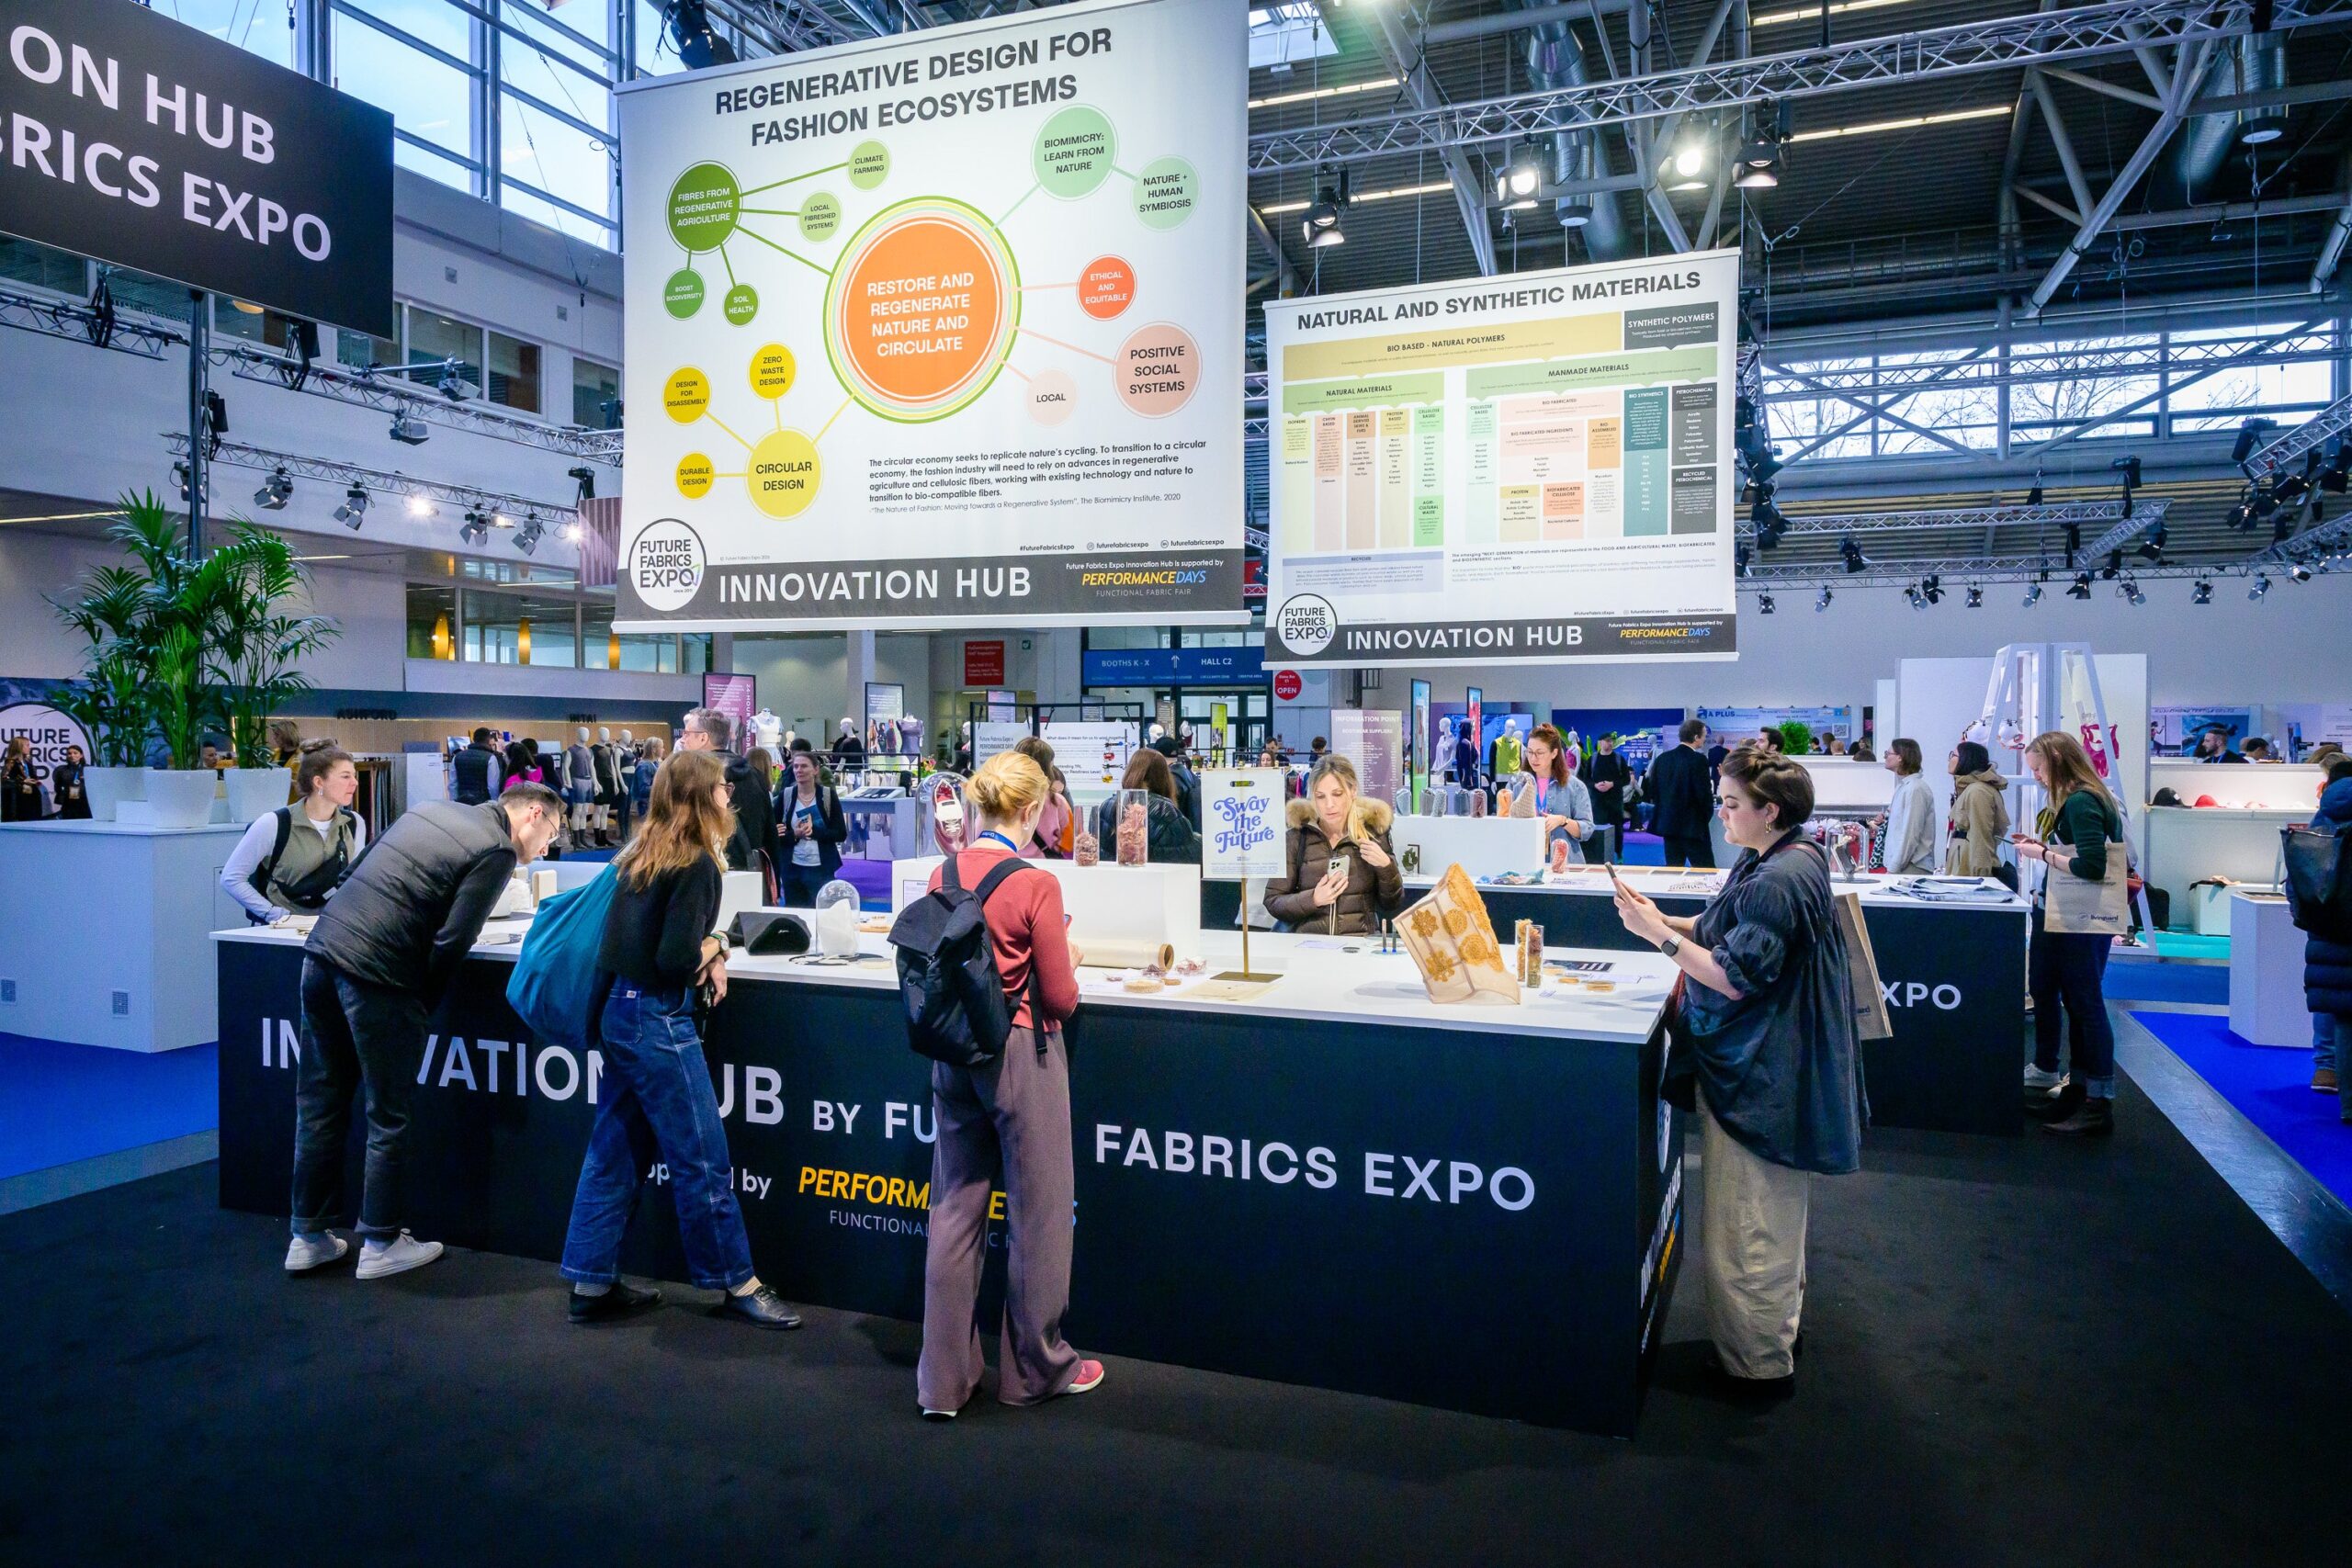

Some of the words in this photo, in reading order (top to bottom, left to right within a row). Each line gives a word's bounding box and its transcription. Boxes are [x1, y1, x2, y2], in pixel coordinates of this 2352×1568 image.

[717, 59, 920, 114] REGENERATIVE
[929, 39, 1038, 80] DESIGN
[1050, 28, 1112, 61] FOR
[10, 25, 119, 110] ON
[146, 73, 276, 164] HUB
[752, 107, 867, 146] FASHION
[878, 74, 1077, 127] ECOSYSTEMS
[1045, 133, 1104, 148] BIOMIMICRY:
[855, 155, 883, 164] CLIMATE
[1044, 152, 1074, 162] LEARN
[1077, 146, 1104, 158] FROM
[854, 165, 884, 175] FARMING
[1057, 162, 1091, 174] NATURE
[0, 113, 161, 208] RICS
[183, 173, 331, 261] EXPO
[1143, 174, 1181, 186] NATURE
[678, 191, 704, 201] FIBRES
[707, 188, 729, 198] FROM
[1148, 186, 1183, 198] HUMAN
[675, 200, 733, 214] REGENERATIVE
[1139, 199, 1191, 212] SYMBIOSIS
[676, 213, 730, 227] AGRICULTURE
[804, 212, 836, 220] FIBRESHED
[807, 221, 833, 230] SYSTEMS
[1091, 271, 1123, 281] ETHICAL
[867, 276, 936, 297] RESTORE
[941, 273, 974, 288] AND
[1098, 283, 1114, 291] AND
[666, 292, 702, 301] BIODIVERSITY
[1085, 294, 1127, 304] EQUITABLE
[1298, 307, 1387, 330] NATURAL
[1395, 300, 1438, 320] AND
[1446, 287, 1565, 314] SYNTHETIC
[1573, 271, 1700, 300] MATERIALS
[729, 306, 753, 314] HEALTH
[871, 294, 970, 316] REGENERATE
[872, 319, 931, 337] NATURE
[935, 315, 968, 331] AND
[1628, 318, 1669, 328] SYNTHETIC
[1672, 312, 1714, 323] POLYMERS
[877, 337, 963, 356] CIRCULATE
[1402, 343, 1424, 351] BASED
[1432, 339, 1464, 348] NATURAL
[1467, 334, 1505, 344] POLYMERS
[1130, 346, 1184, 359] POSITIVE
[761, 367, 785, 375] WASTE
[1135, 365, 1181, 377] SOCIAL
[1548, 367, 1588, 377] MANMADE
[1589, 364, 1629, 373] MATERIALS
[760, 378, 785, 386] DESIGN
[1129, 381, 1185, 394] SYSTEMS
[1357, 385, 1392, 394] MATERIALS
[1036, 394, 1066, 402] LOCAL
[884, 457, 913, 466] circular
[916, 456, 953, 465] economy
[956, 454, 978, 462] seeks
[990, 451, 1027, 462] replicate
[1065, 446, 1098, 457] cycling.
[1113, 444, 1151, 453] transition
[1173, 441, 1206, 449] circular
[756, 462, 812, 474] CIRCULAR
[924, 467, 953, 475] fashion
[956, 465, 986, 474] industry
[1037, 461, 1053, 470] rely
[1068, 458, 1111, 468] advances
[1123, 455, 1179, 466] regenerative
[763, 479, 804, 491] DESIGN
[870, 482, 910, 491] agriculture
[930, 479, 967, 488] cellulosic
[995, 476, 1028, 484] working
[1030, 474, 1046, 482] with
[1048, 472, 1080, 481] existing
[1083, 468, 1131, 479] technology
[1135, 468, 1151, 476] and
[869, 493, 902, 502] transition
[915, 490, 977, 500] bio-compatible
[640, 539, 691, 553] FUTURE
[640, 554, 692, 568] FABRICS
[640, 568, 695, 588] EXPO
[1082, 570, 1206, 585] PERFORMANCEDAYS
[720, 569, 937, 603] INNOVATION
[956, 567, 1030, 598] HUB
[1285, 607, 1325, 616] FUTURE
[1285, 617, 1326, 626] FABRICS
[1285, 627, 1328, 640] EXPO
[1348, 627, 1513, 650] INNOVATION
[1527, 626, 1583, 646] HUB
[1621, 628, 1710, 637] PERFORMANCEDAYS
[1214, 796, 1270, 821] Sway
[1235, 813, 1261, 833] the
[1215, 827, 1274, 853] Future
[1880, 982, 1961, 1010] XPO
[813, 1100, 861, 1134] BY
[1096, 1123, 1338, 1189] FABRICS
[1364, 1152, 1534, 1212] EXPO
[742, 1168, 772, 1200] by
